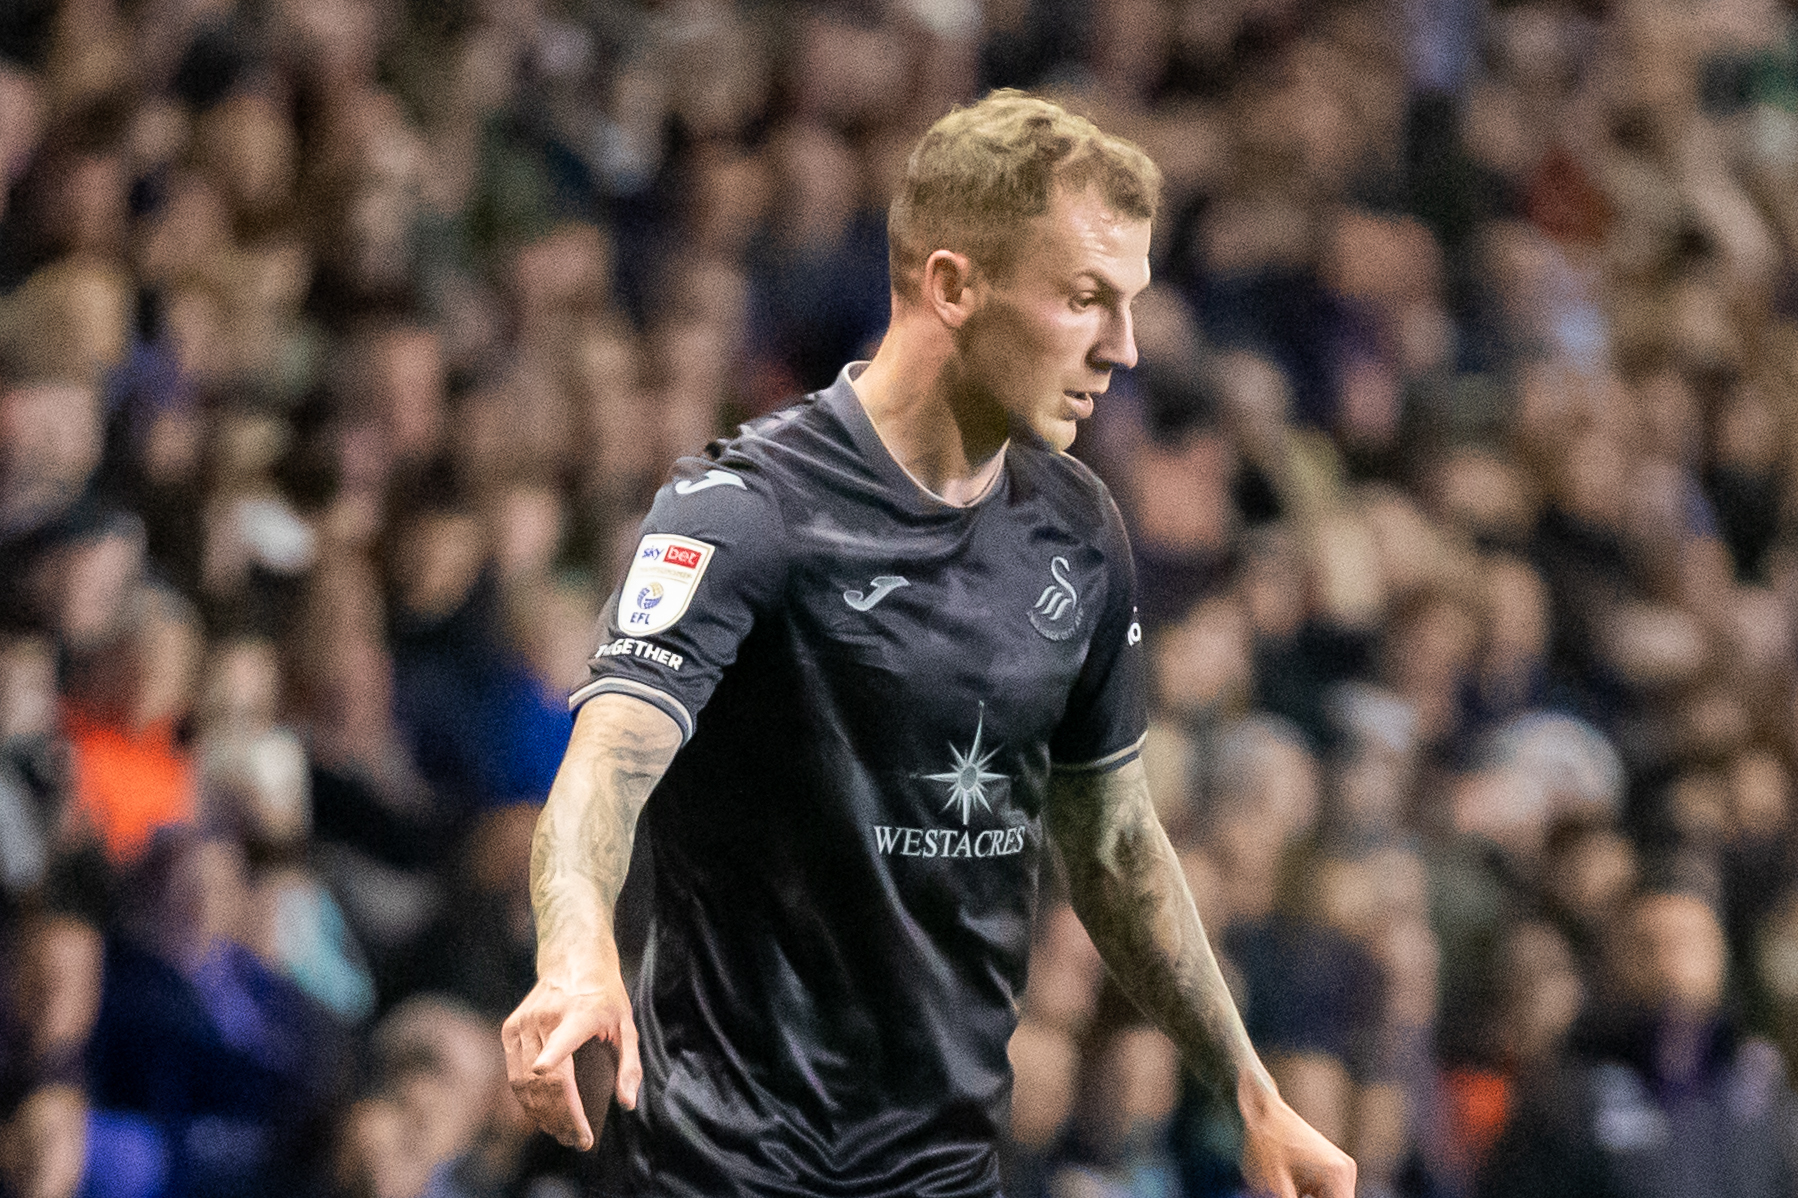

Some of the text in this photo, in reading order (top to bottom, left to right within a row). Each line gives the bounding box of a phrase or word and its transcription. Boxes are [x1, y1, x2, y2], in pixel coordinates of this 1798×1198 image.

[642, 545, 697, 566] sky bet
[630, 612, 651, 625] EFL
[872, 825, 1026, 859] WESTACRES
